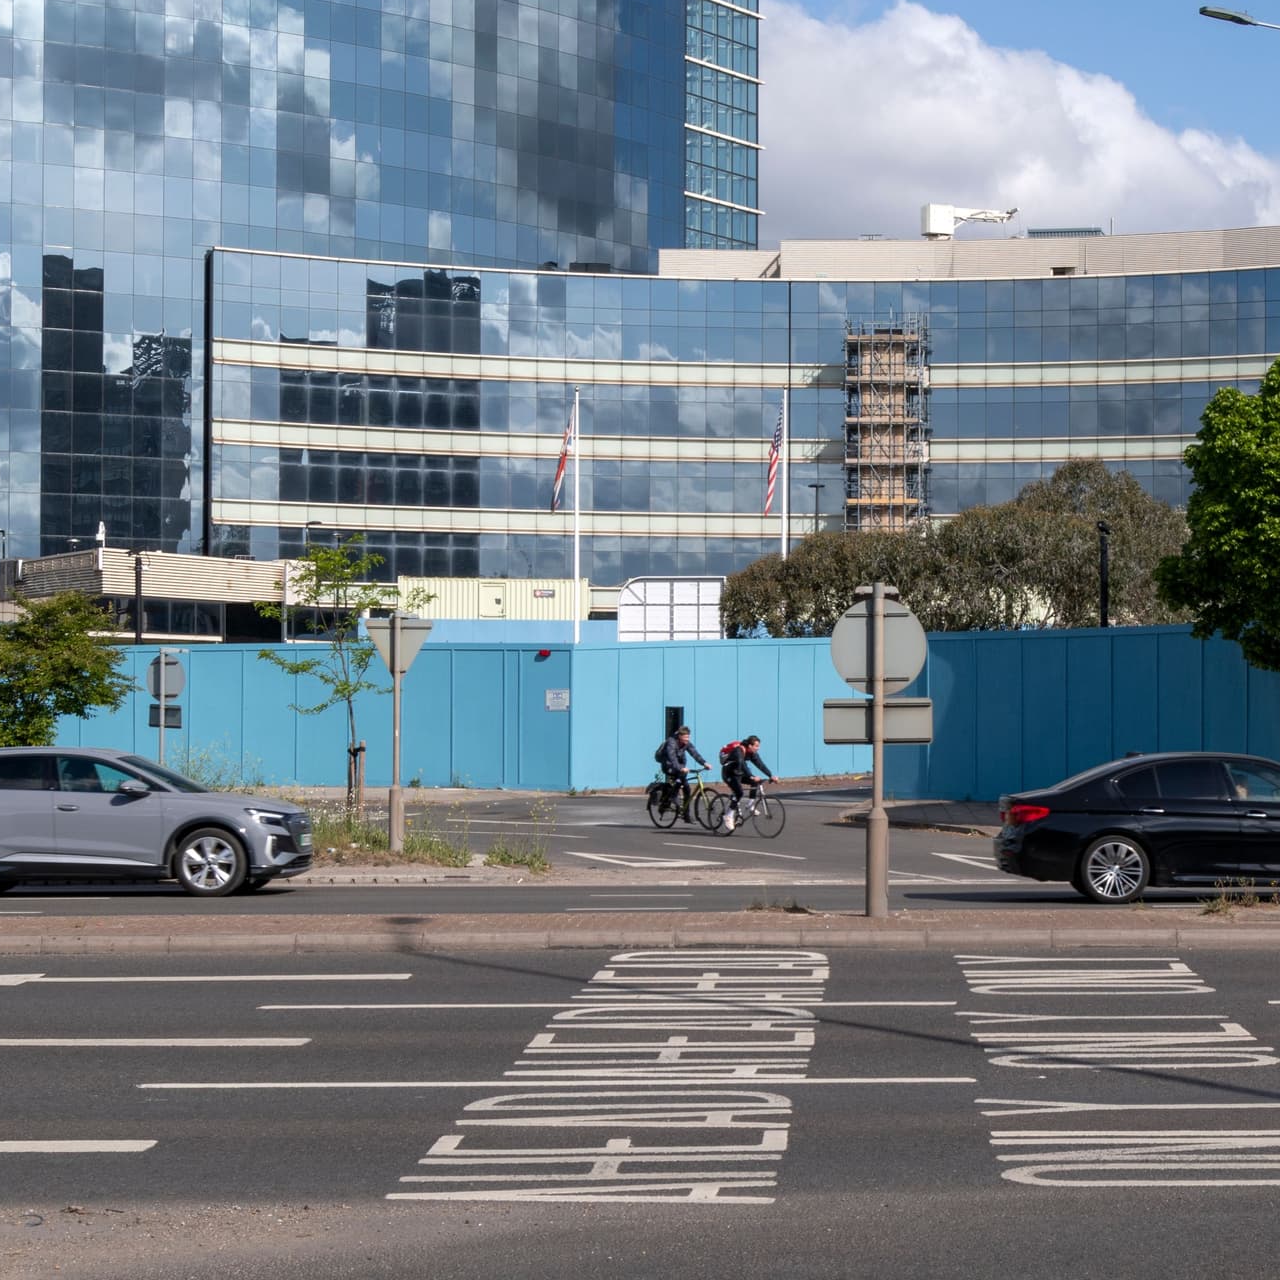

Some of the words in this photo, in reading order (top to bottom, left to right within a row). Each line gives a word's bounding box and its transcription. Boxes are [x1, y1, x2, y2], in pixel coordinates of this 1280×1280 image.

[571, 951, 829, 1001] AHEAD
[954, 955, 1216, 995] ONLY
[504, 1007, 819, 1078] AHEAD
[385, 1091, 792, 1204] AHEAD
